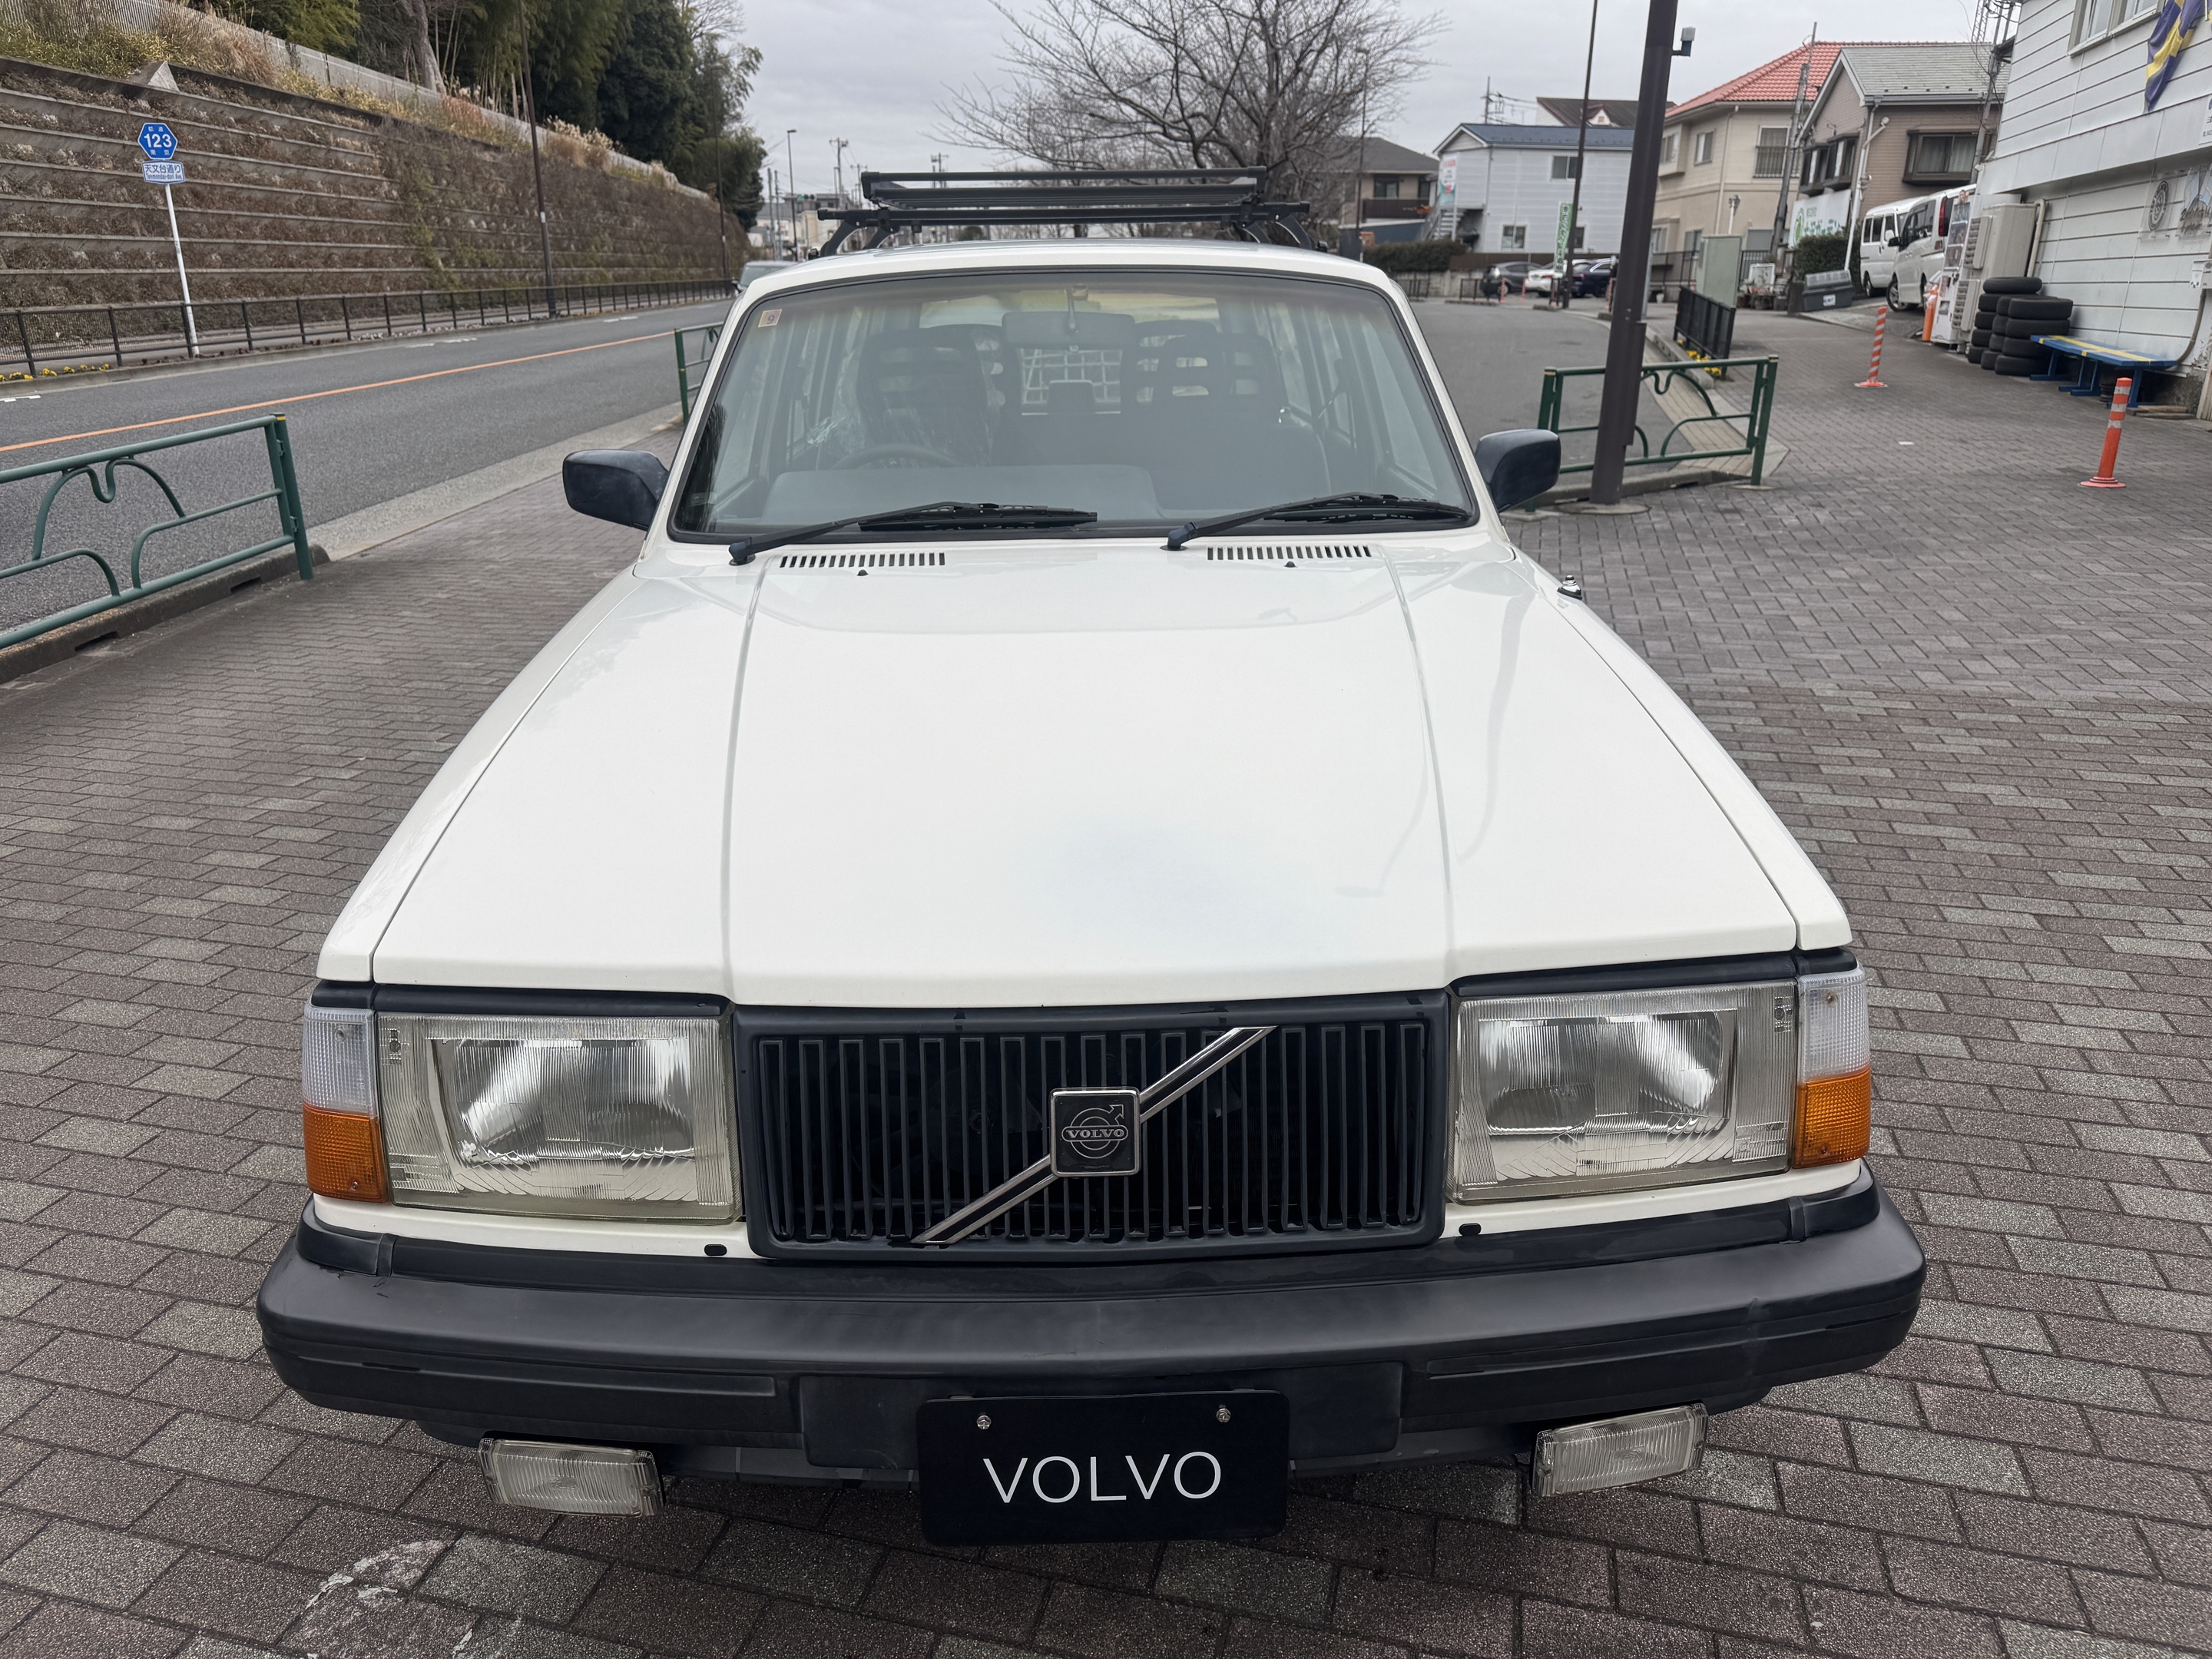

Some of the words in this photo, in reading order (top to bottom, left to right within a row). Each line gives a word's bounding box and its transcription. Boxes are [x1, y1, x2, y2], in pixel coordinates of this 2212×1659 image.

[144, 133, 172, 147] 123
[144, 164, 181, 174] 天文台通り
[767, 314, 775, 325] 9
[1066, 1129, 1124, 1138] VOLVO
[983, 1452, 1221, 1503] VOLVO
